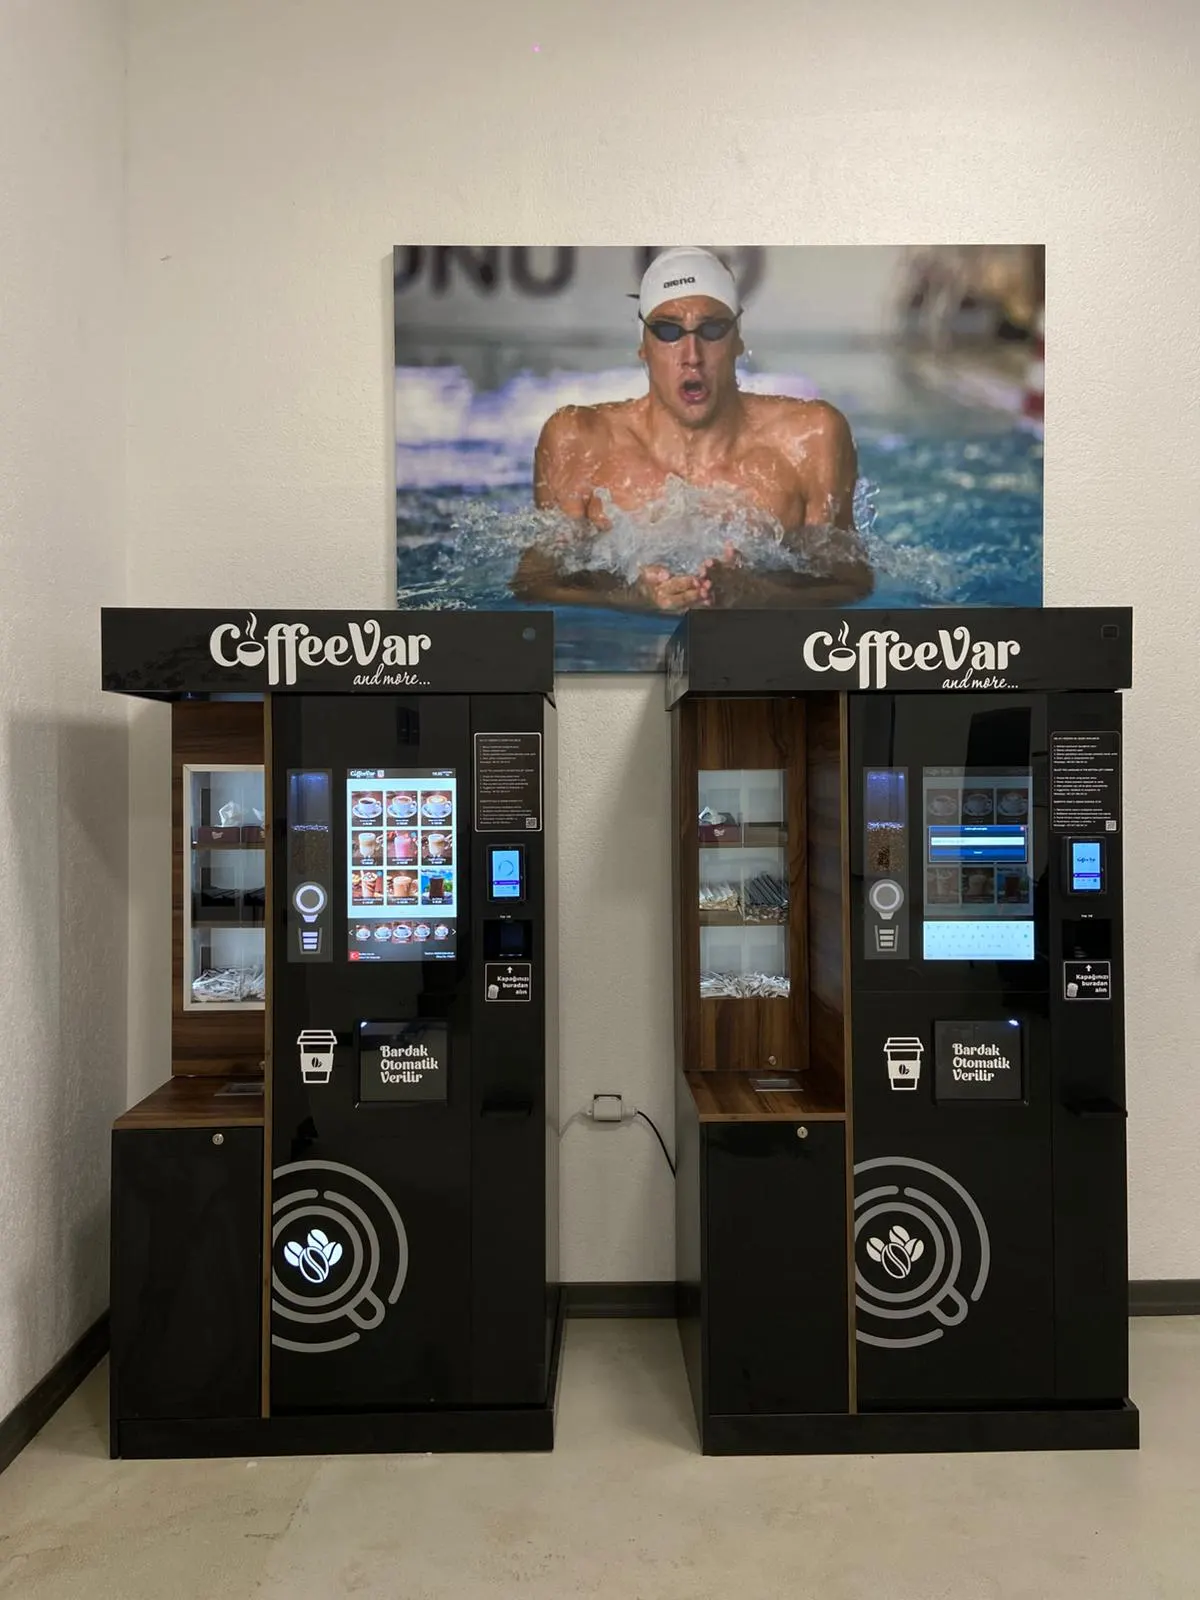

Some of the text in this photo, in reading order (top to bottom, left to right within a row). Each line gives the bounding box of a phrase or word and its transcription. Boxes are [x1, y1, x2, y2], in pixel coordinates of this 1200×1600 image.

[663, 276, 696, 288] arena
[209, 612, 432, 686] CoffeeVar
[803, 620, 1021, 689] CoffeeVar
[353, 663, 431, 686] and more...
[942, 668, 1019, 689] and more...
[380, 1044, 428, 1058] Bardak
[952, 1043, 1000, 1056] Bardak
[380, 1057, 439, 1071] Otomatik
[952, 1056, 1010, 1069] Otomatik
[380, 1071, 423, 1083] Verilir
[952, 1069, 995, 1081] Verilir
